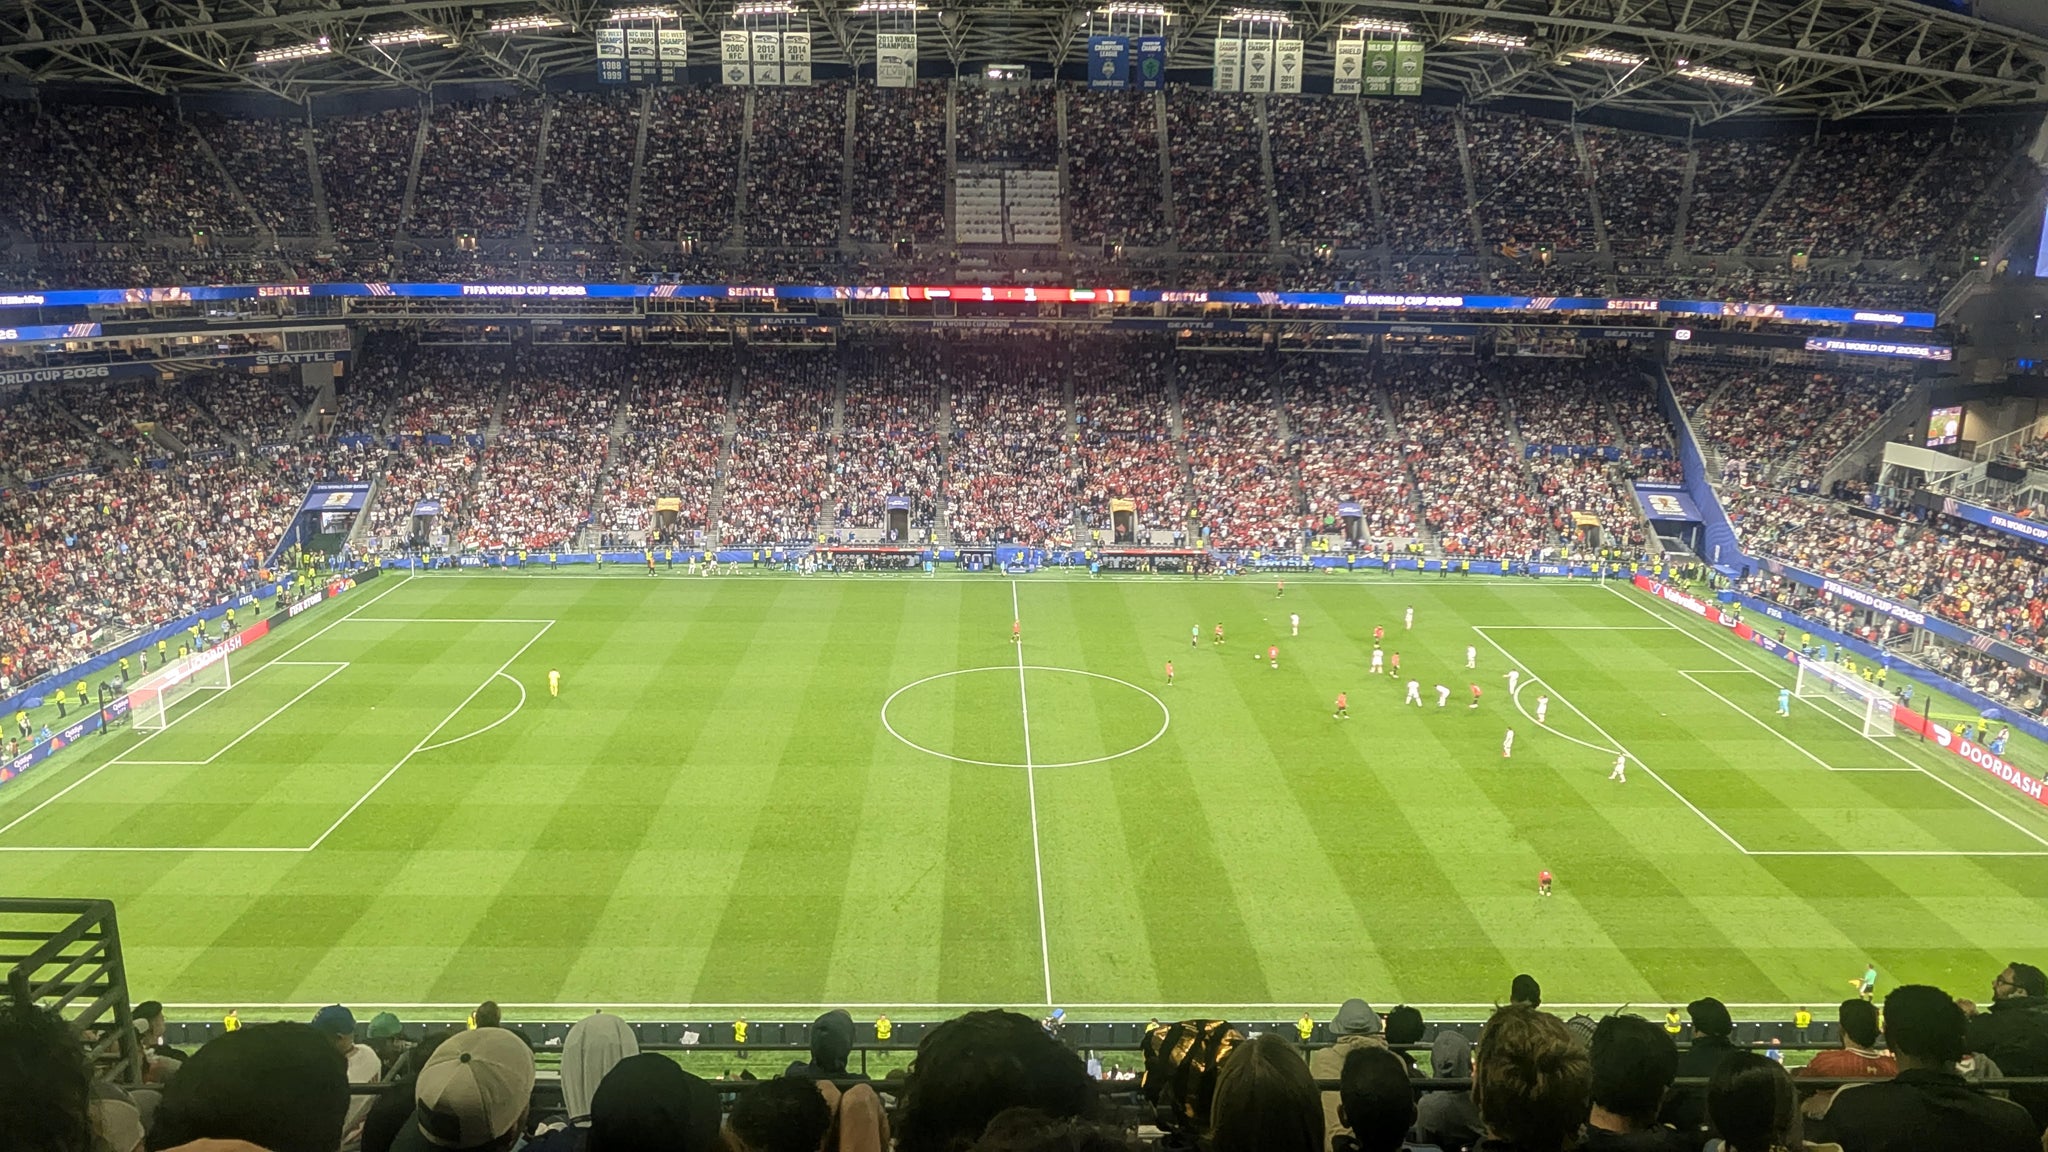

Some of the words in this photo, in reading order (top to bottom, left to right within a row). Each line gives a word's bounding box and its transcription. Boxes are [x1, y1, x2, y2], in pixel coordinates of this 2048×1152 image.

[259, 286, 310, 296] SEATTLE
[463, 286, 487, 295] FIFA
[487, 286, 526, 295] WORLD
[527, 286, 548, 295] CUP
[549, 286, 586, 295] 2026
[728, 288, 774, 296] SEATTLE
[1162, 292, 1208, 302] SEATTLE
[1345, 295, 1367, 304] FIFA
[1368, 296, 1404, 305] WORLD
[1405, 296, 1426, 305] CUP
[1607, 300, 1658, 310] SEATTLE
[1826, 341, 1845, 349] FIFA
[1846, 343, 1876, 352] WORLD
[1878, 344, 1896, 353] CUP
[1896, 346, 1929, 355] 2026
[256, 352, 335, 364] SEATTLE
[34, 371, 60, 382] CUP
[63, 367, 109, 379] 2026
[1992, 516, 2007, 527] FIFA
[2007, 520, 2032, 534] WORLD
[2032, 528, 2048, 538] CUP
[239, 594, 253, 606] FIFA
[289, 601, 304, 617] FIFA
[304, 592, 322, 609] STORE
[1823, 580, 1842, 594] FIFA
[1843, 586, 1873, 605] WORLD
[1873, 598, 1892, 611] CUP
[1891, 605, 1925, 625] 2026
[1767, 607, 1782, 619] FIFA
[70, 733, 80, 742] CITY
[19, 762, 30, 772] CITY
[1960, 742, 2042, 799] DOORDASH
